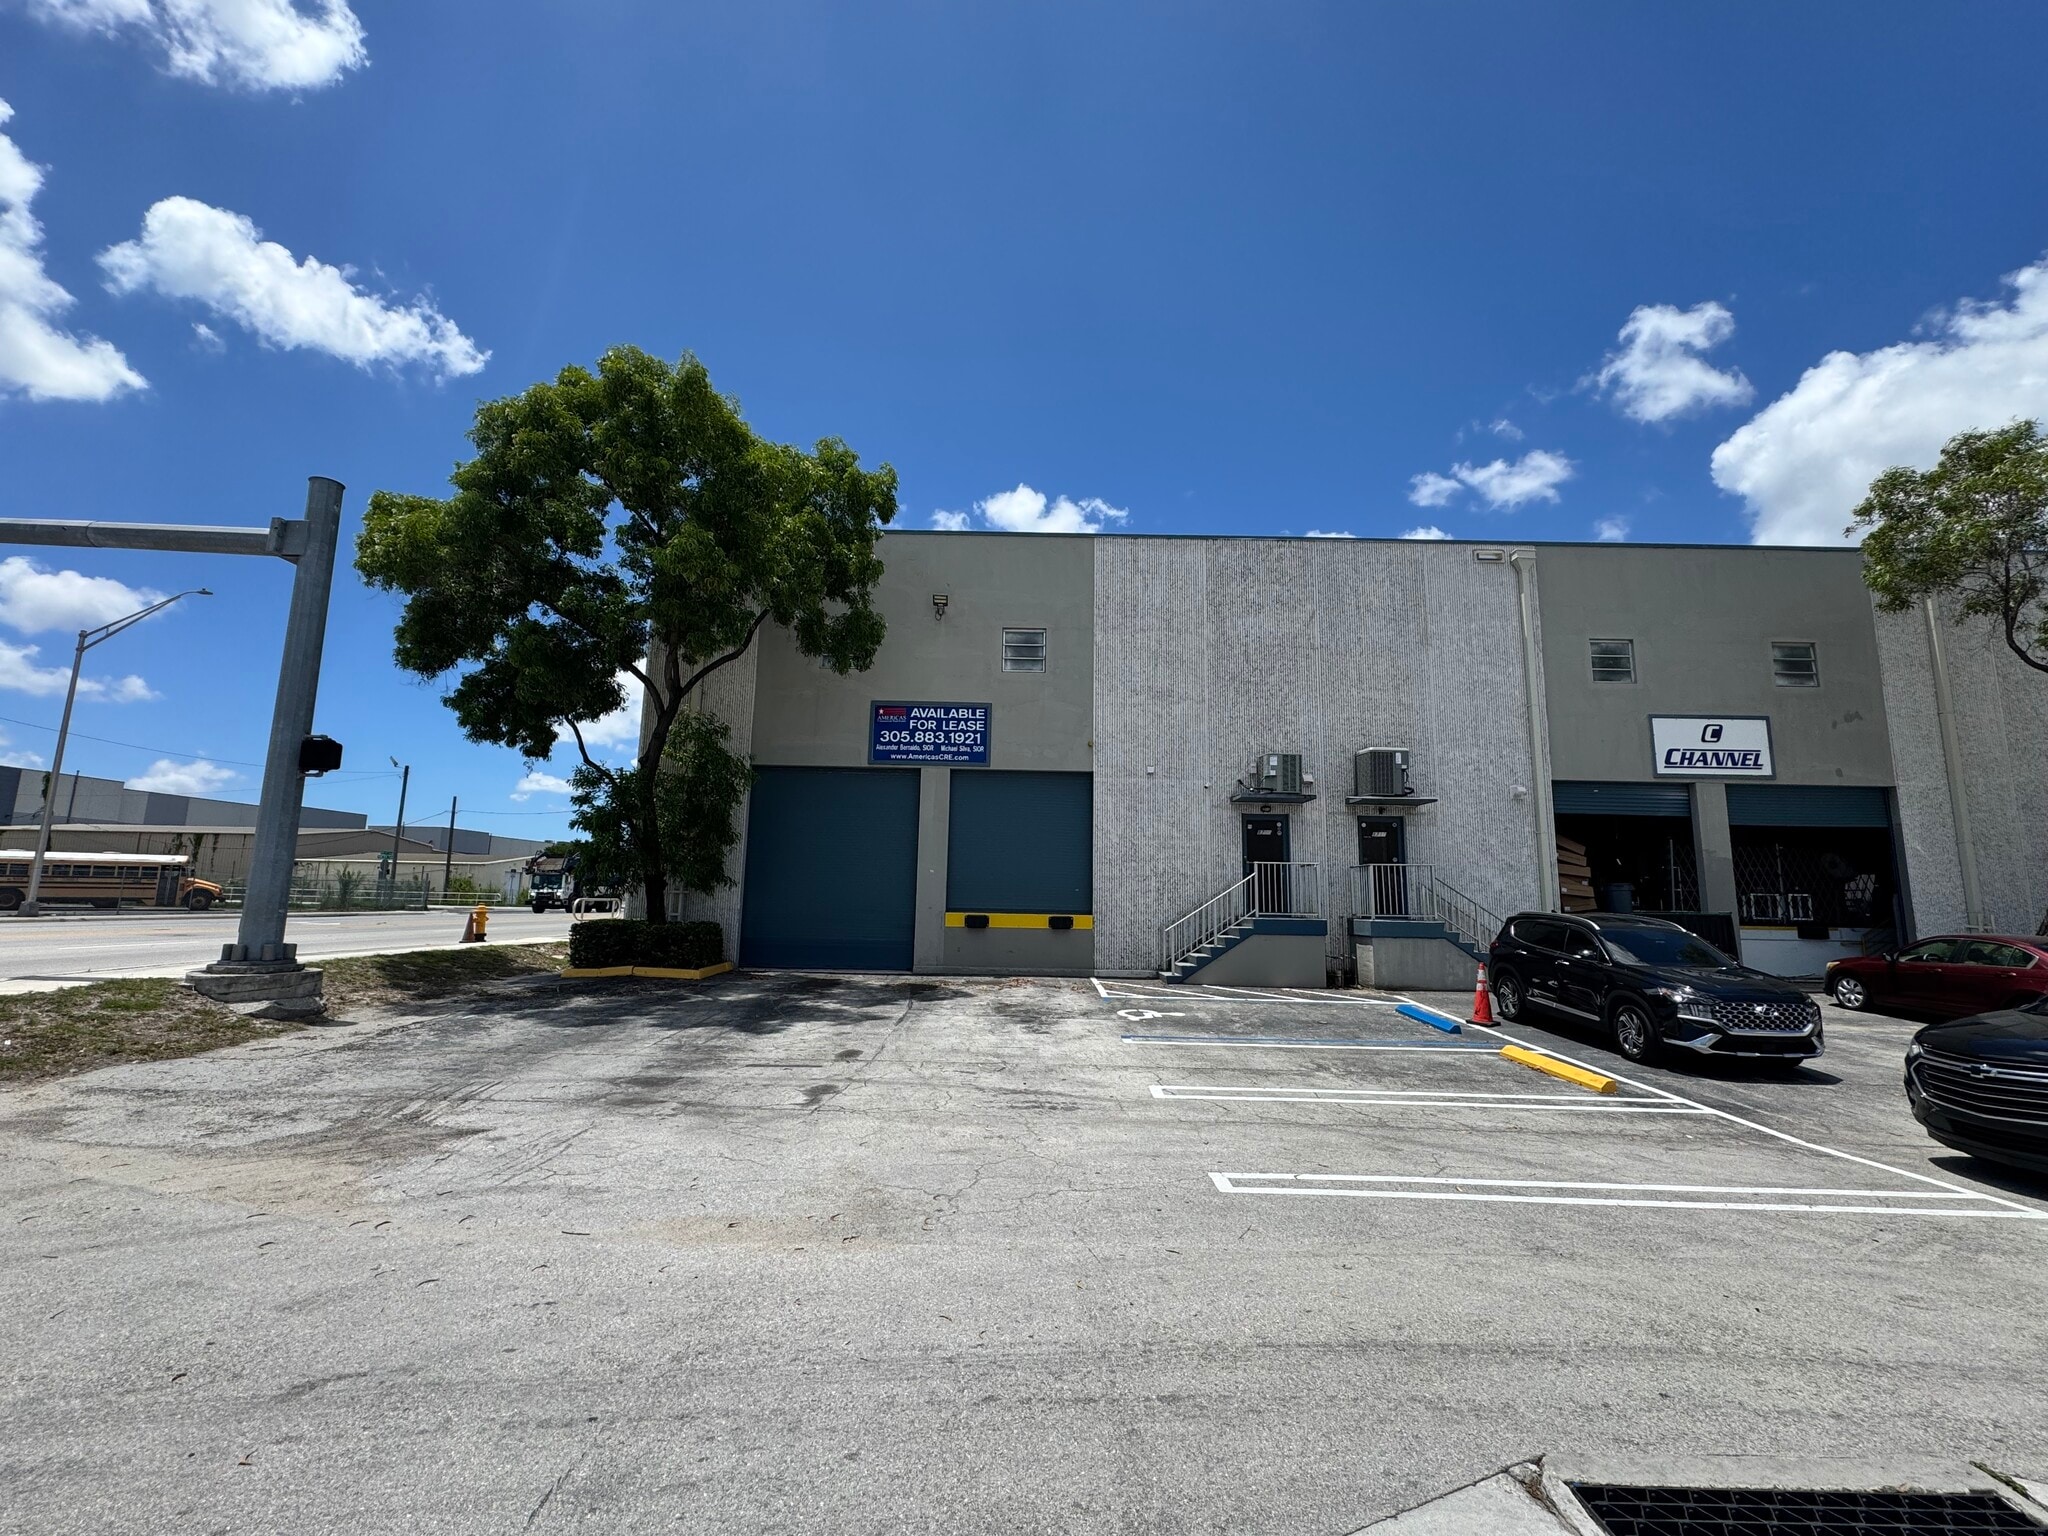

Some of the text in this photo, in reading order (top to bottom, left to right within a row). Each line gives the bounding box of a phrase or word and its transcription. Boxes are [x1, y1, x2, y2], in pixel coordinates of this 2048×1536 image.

[910, 708, 985, 719] AVAILABLE
[909, 720, 985, 731] FOR LEASE
[880, 731, 981, 744] 305.883.1921
[890, 753, 970, 761] www.AmericasCRE.com
[1664, 748, 1764, 767] CHANNEL
